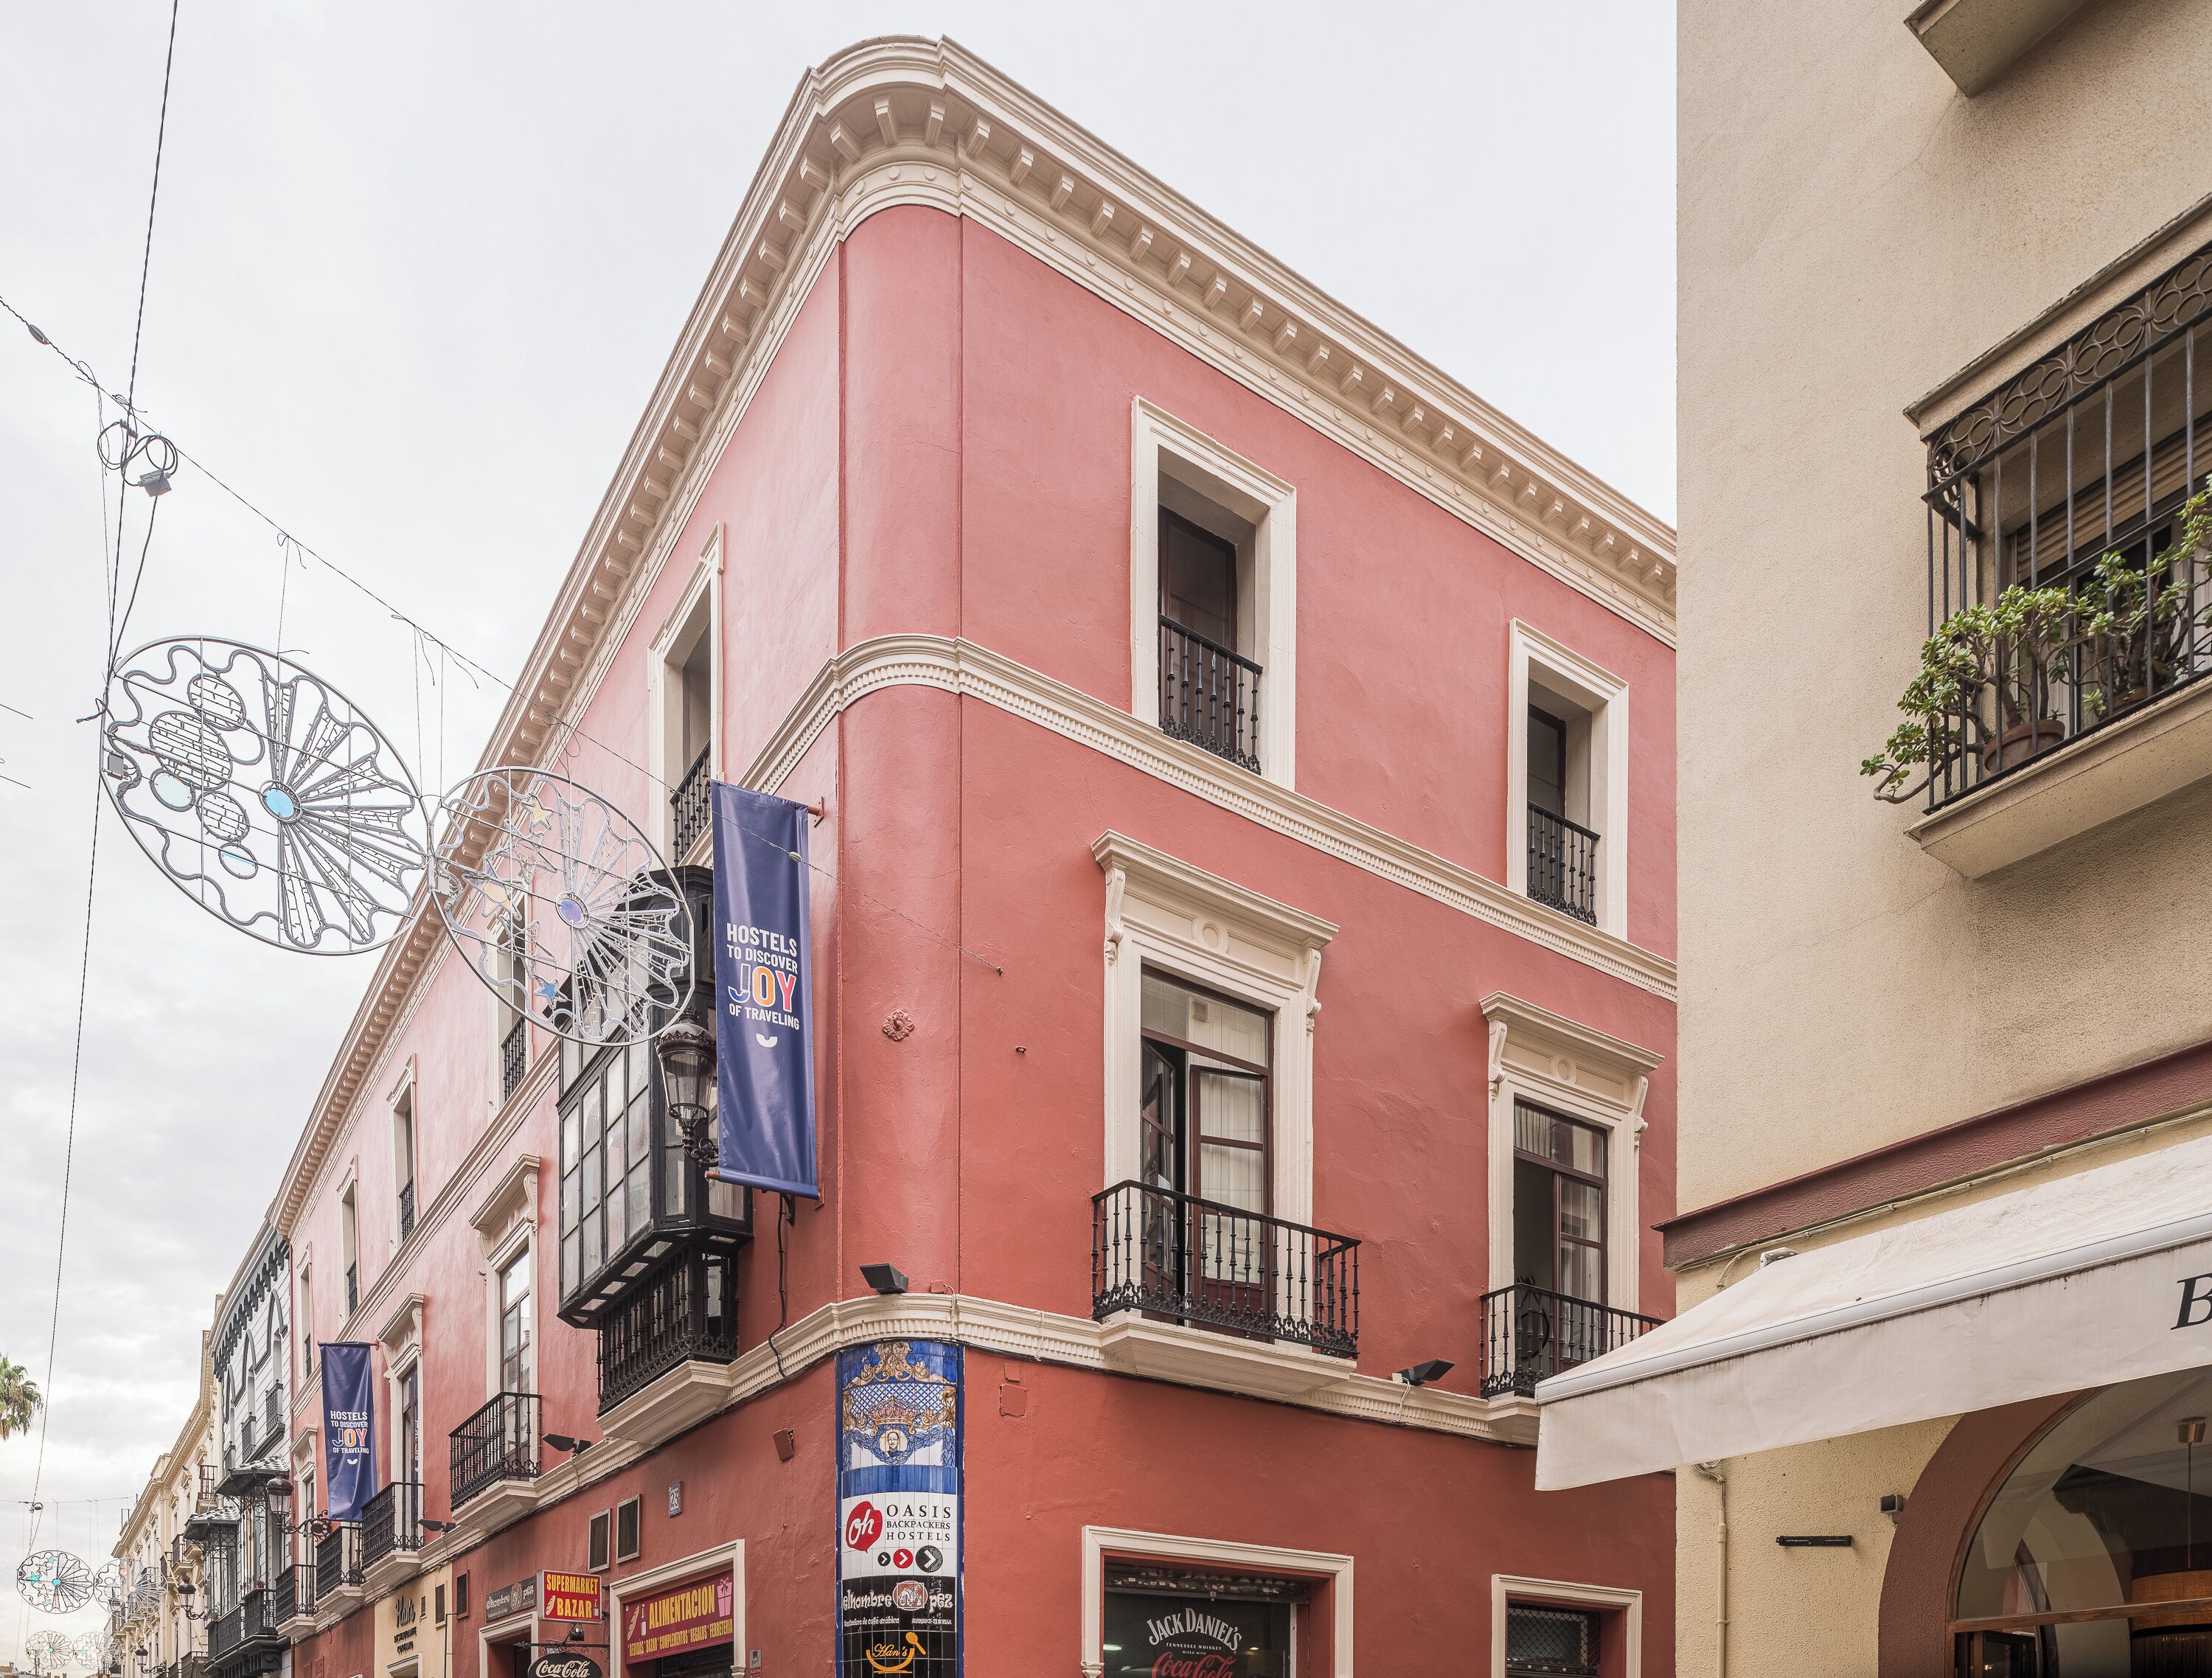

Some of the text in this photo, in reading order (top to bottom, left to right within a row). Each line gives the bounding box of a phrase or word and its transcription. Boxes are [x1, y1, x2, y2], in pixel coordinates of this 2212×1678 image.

[726, 922, 797, 958] HOSTELS
[726, 944, 798, 974] TO DISCOVER
[728, 963, 797, 1013] JOY
[728, 1003, 800, 1030] OF TRAVELING
[330, 1410, 368, 1421] HOSTELS
[332, 1428, 368, 1447] JOY
[670, 1490, 679, 1508] 23
[886, 1504, 951, 1519] OASIS
[886, 1520, 950, 1530] BACKPACKERS
[886, 1531, 950, 1541] HOSTELS
[523, 1585, 534, 1600] pez
[546, 1573, 599, 1595] SUPERMARKET
[557, 1598, 592, 1618] BAZAR
[649, 1584, 715, 1630] ALIMENTACION
[928, 1593, 953, 1613] pez
[862, 1617, 868, 1625] de
[868, 1616, 879, 1625] café
[1147, 1607, 1243, 1651] JACK DANIEL'S
[645, 1637, 658, 1653] BAZAR
[659, 1629, 688, 1650] COMPLEMENTOS
[690, 1625, 707, 1643] REGALOS
[535, 1660, 590, 1678] Coca-Cola
